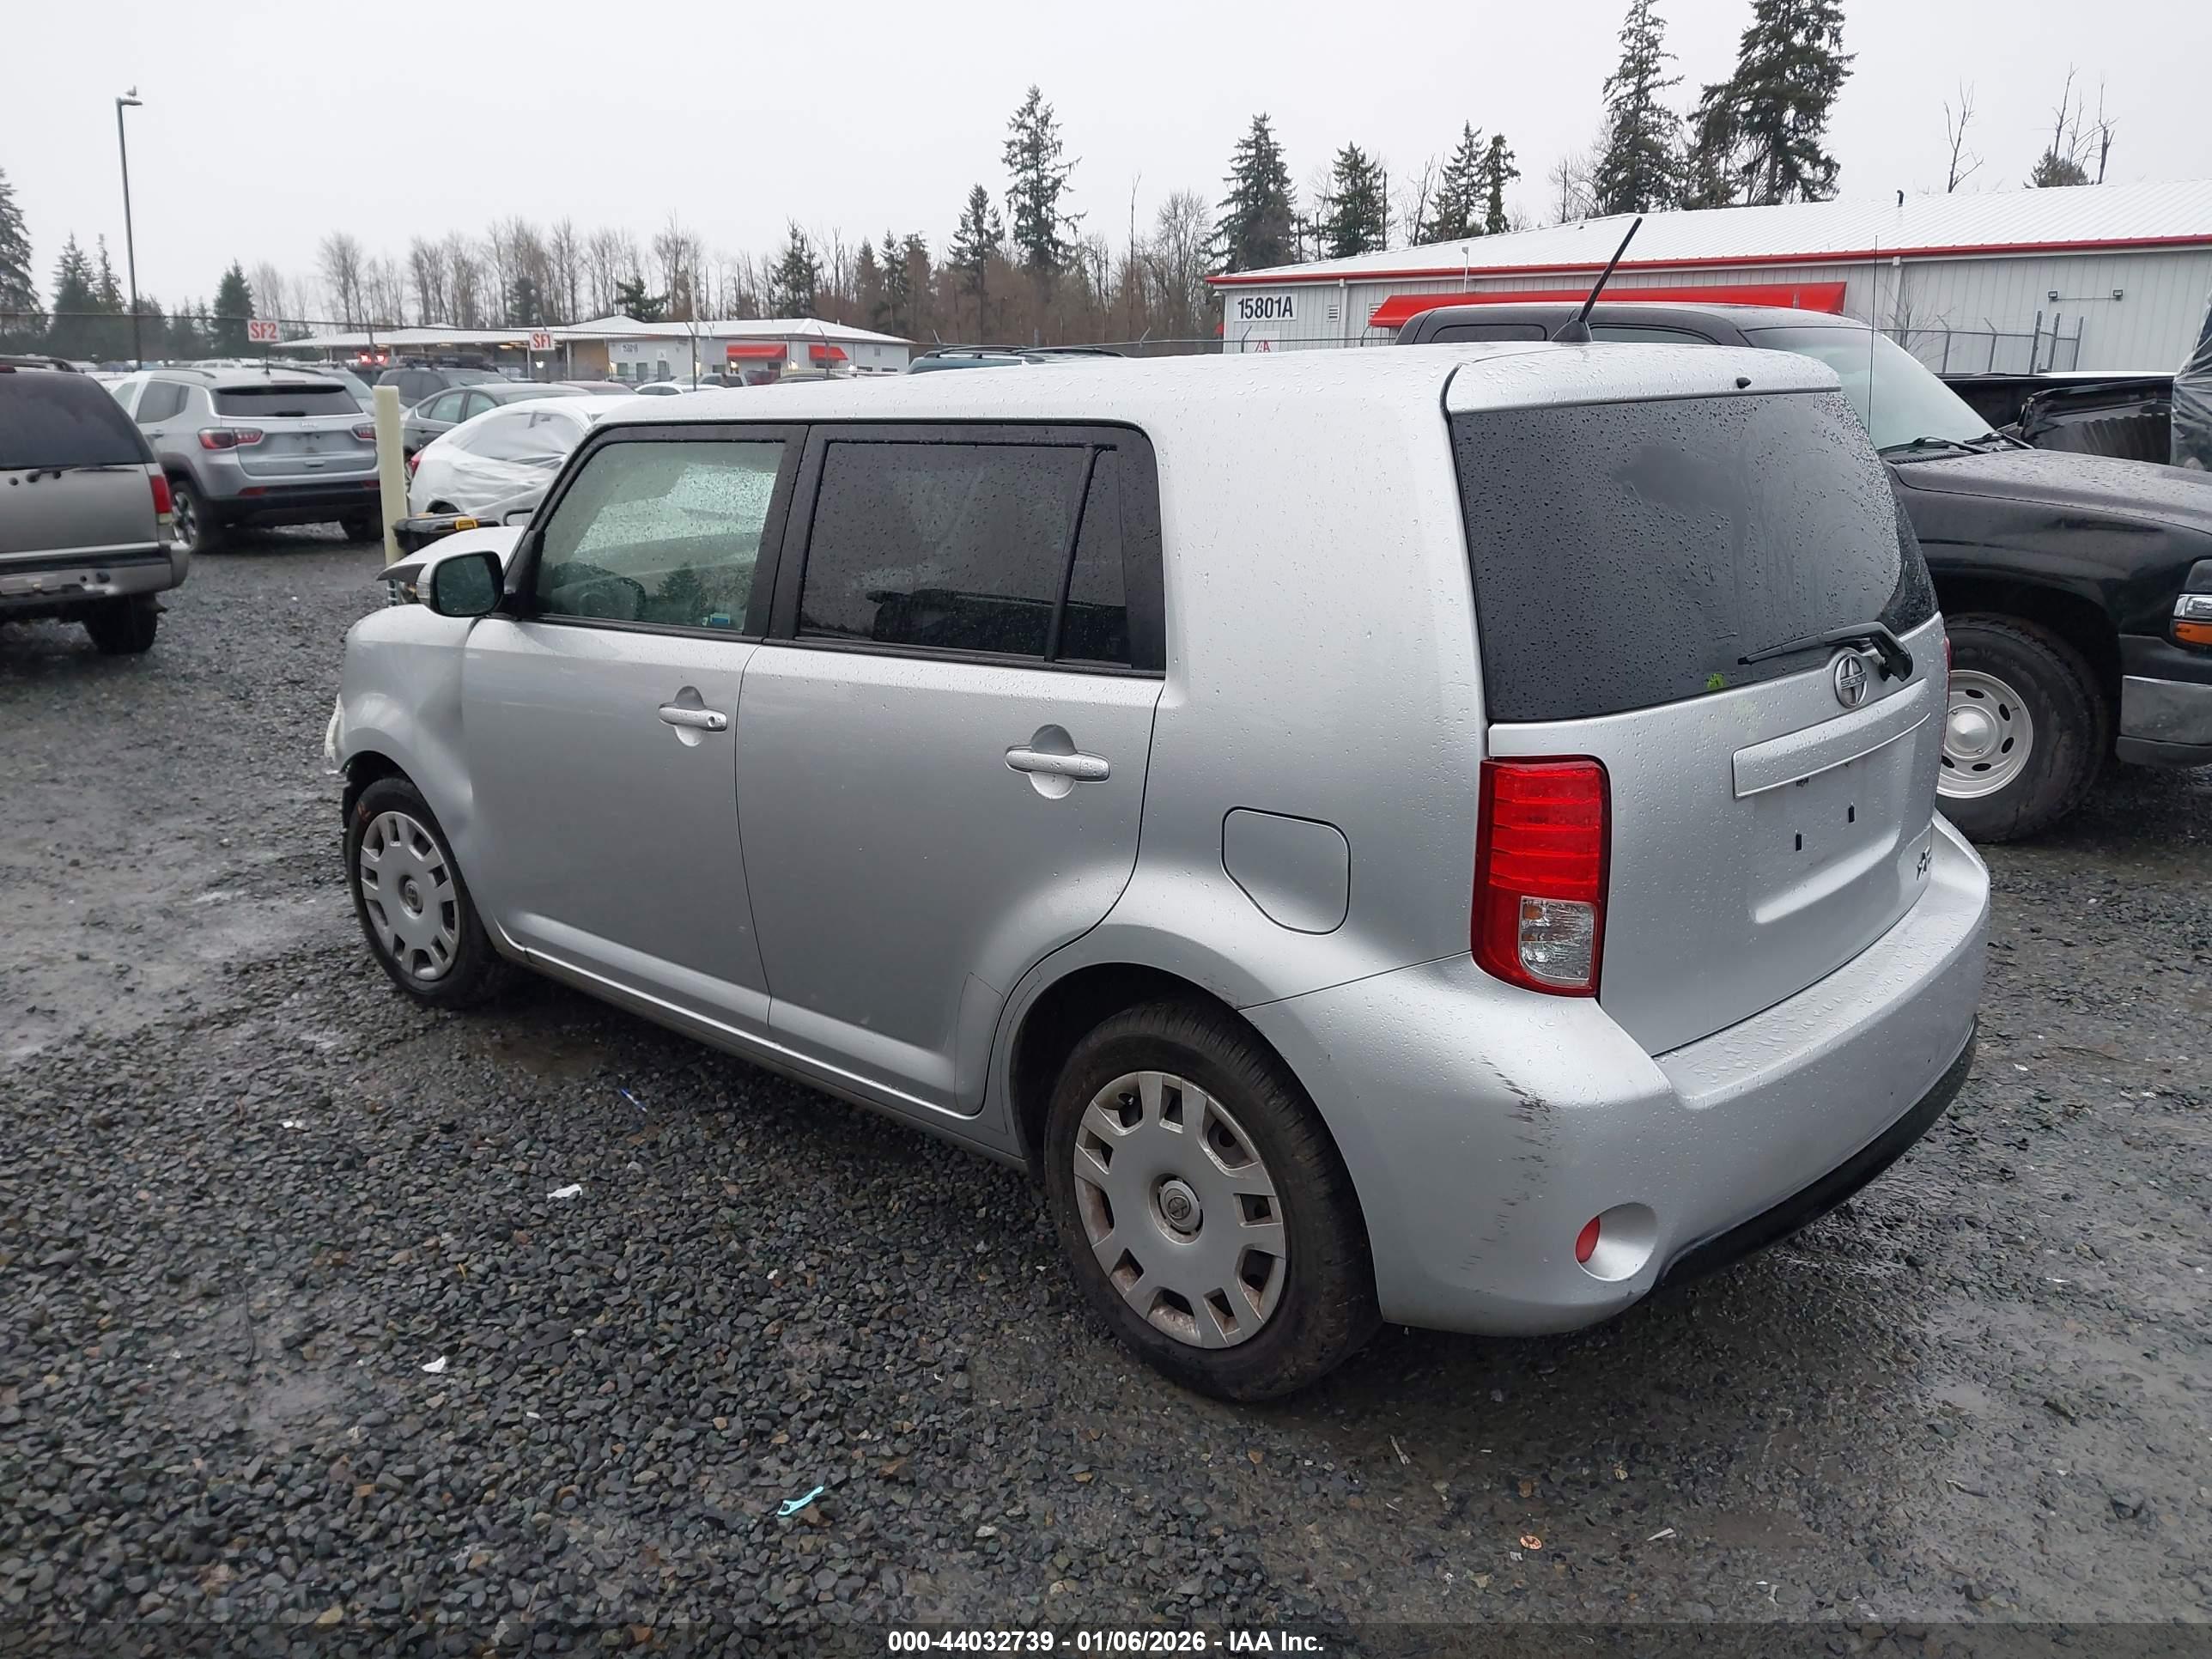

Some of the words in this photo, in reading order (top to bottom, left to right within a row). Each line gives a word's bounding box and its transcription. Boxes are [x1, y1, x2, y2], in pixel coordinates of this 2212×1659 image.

[1237, 296, 1293, 319] 15801A
[251, 322, 277, 339] SF2
[532, 333, 551, 349] SF1
